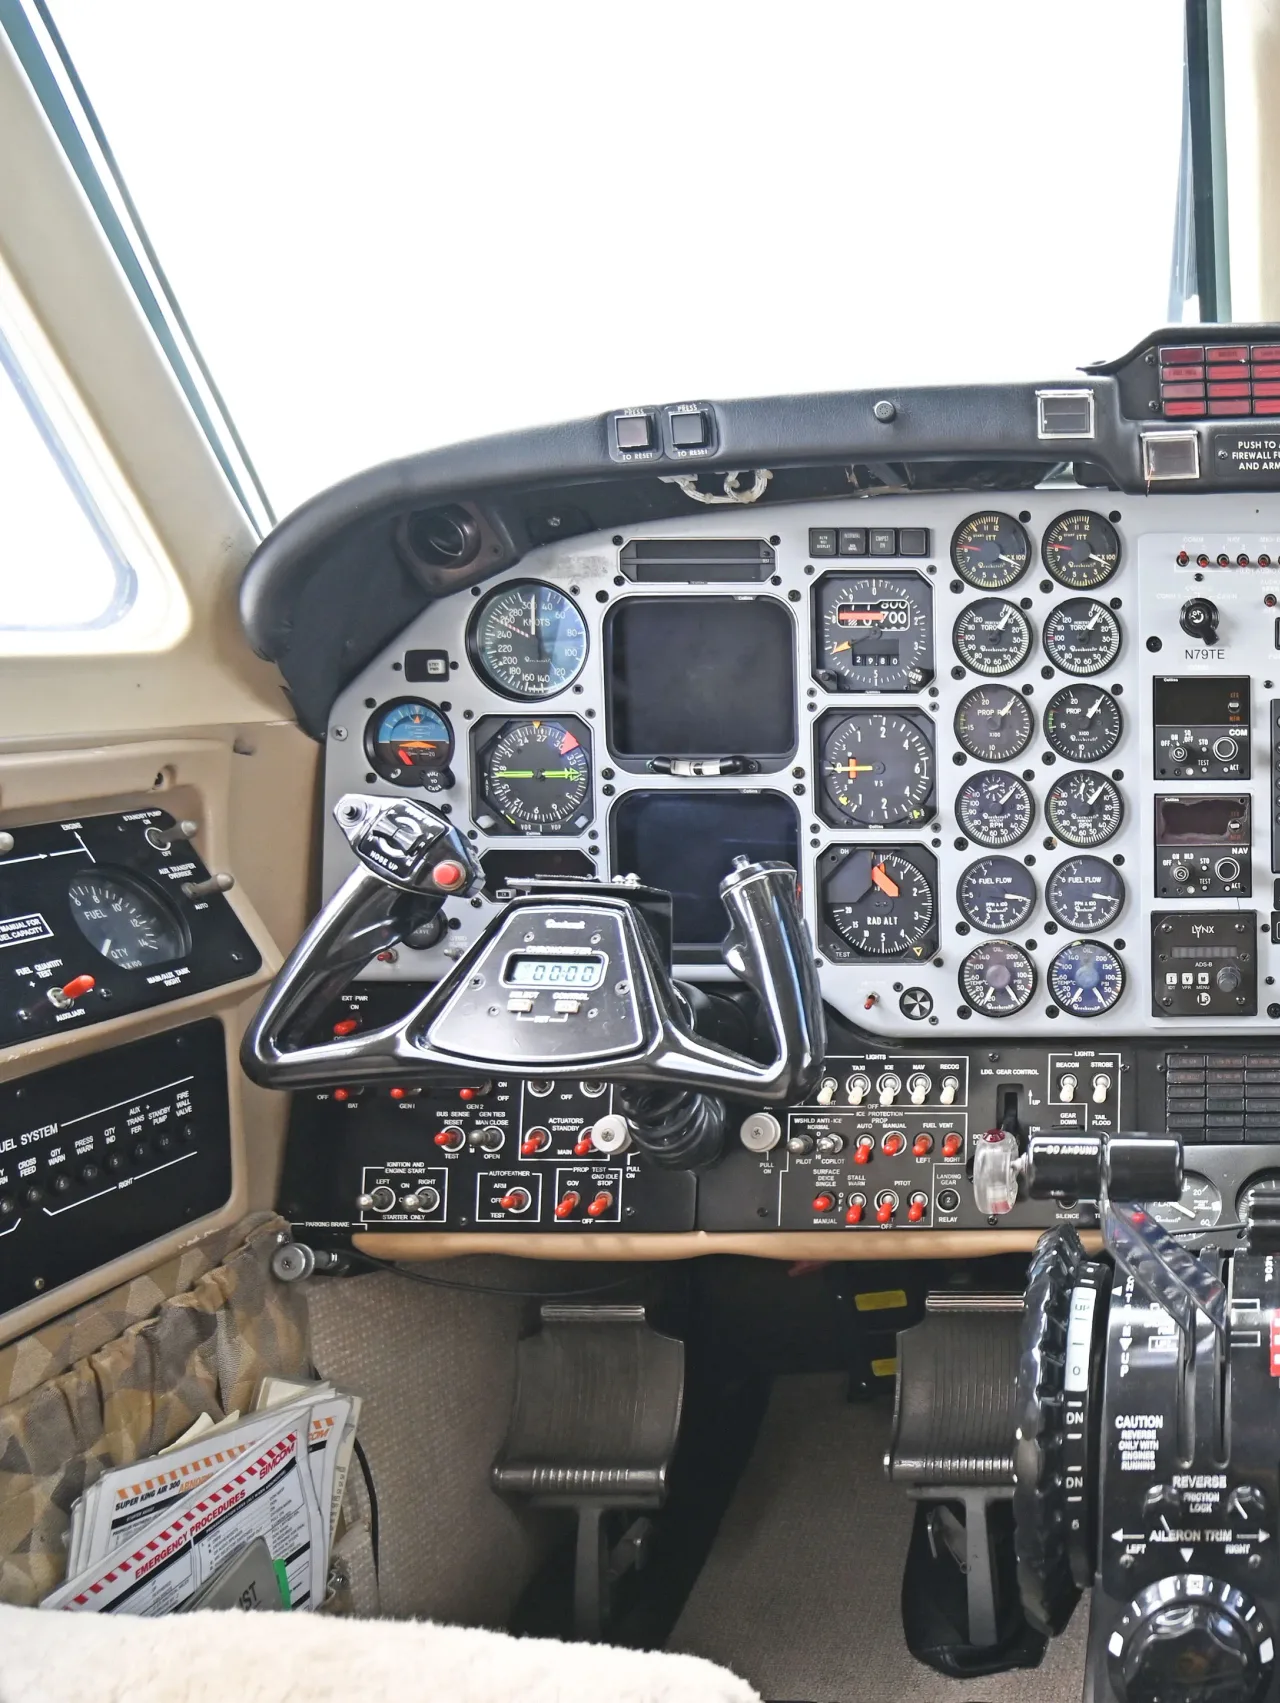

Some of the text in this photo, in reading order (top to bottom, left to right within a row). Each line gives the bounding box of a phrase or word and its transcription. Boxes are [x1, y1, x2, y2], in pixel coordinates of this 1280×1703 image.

[624, 408, 644, 416] PRESS
[677, 404, 697, 412] PRESS
[1238, 441, 1261, 449] PUSH
[1264, 441, 1275, 449] TO
[634, 452, 653, 460] RESET
[689, 449, 708, 457] RESET
[1231, 451, 1271, 460] FIREWALL
[1238, 462, 1259, 470] AND
[1261, 461, 1280, 470] ARM
[497, 630, 513, 639] 240
[566, 628, 577, 637] 80
[497, 644, 513, 653] 220
[564, 648, 577, 657] 100
[1184, 648, 1225, 660] N79TE
[503, 656, 518, 665] 200
[1228, 729, 1248, 737] COM
[1231, 847, 1249, 855] NAV
[84, 909, 107, 921] FUEL
[866, 916, 898, 925] RAD ALT
[0, 918, 42, 934] MANUAL FOR
[1191, 925, 1215, 938] LYNX
[11, 927, 43, 940] CAPACITY
[111, 948, 128, 958] QTY
[15, 959, 64, 977] FUEL QUANTITY
[533, 965, 595, 982] 00:00
[176, 1090, 189, 1100] FIRE
[176, 1098, 191, 1108] WALL
[175, 1104, 192, 1117] VALVE
[20, 1123, 59, 1146] SYSTEM
[74, 1135, 94, 1148] PRESS
[76, 1143, 94, 1155] WARN
[18, 1157, 37, 1171] CROSS
[19, 1166, 37, 1178] FEED
[118, 1177, 134, 1190] RIGHT
[1066, 1412, 1084, 1424] DN
[1115, 1415, 1163, 1429] CAUTION
[258, 1442, 296, 1480] SIMCOM
[1172, 1475, 1227, 1488] REVERSE
[115, 1479, 181, 1511] SUPER KING AIR 300
[134, 1533, 188, 1579] EMERGENCY
[189, 1489, 246, 1537] PROCEDURES
[1149, 1529, 1232, 1542] AILERON TRIM
[1125, 1545, 1146, 1554] LEFT
[1225, 1544, 1250, 1554] RIGHT
